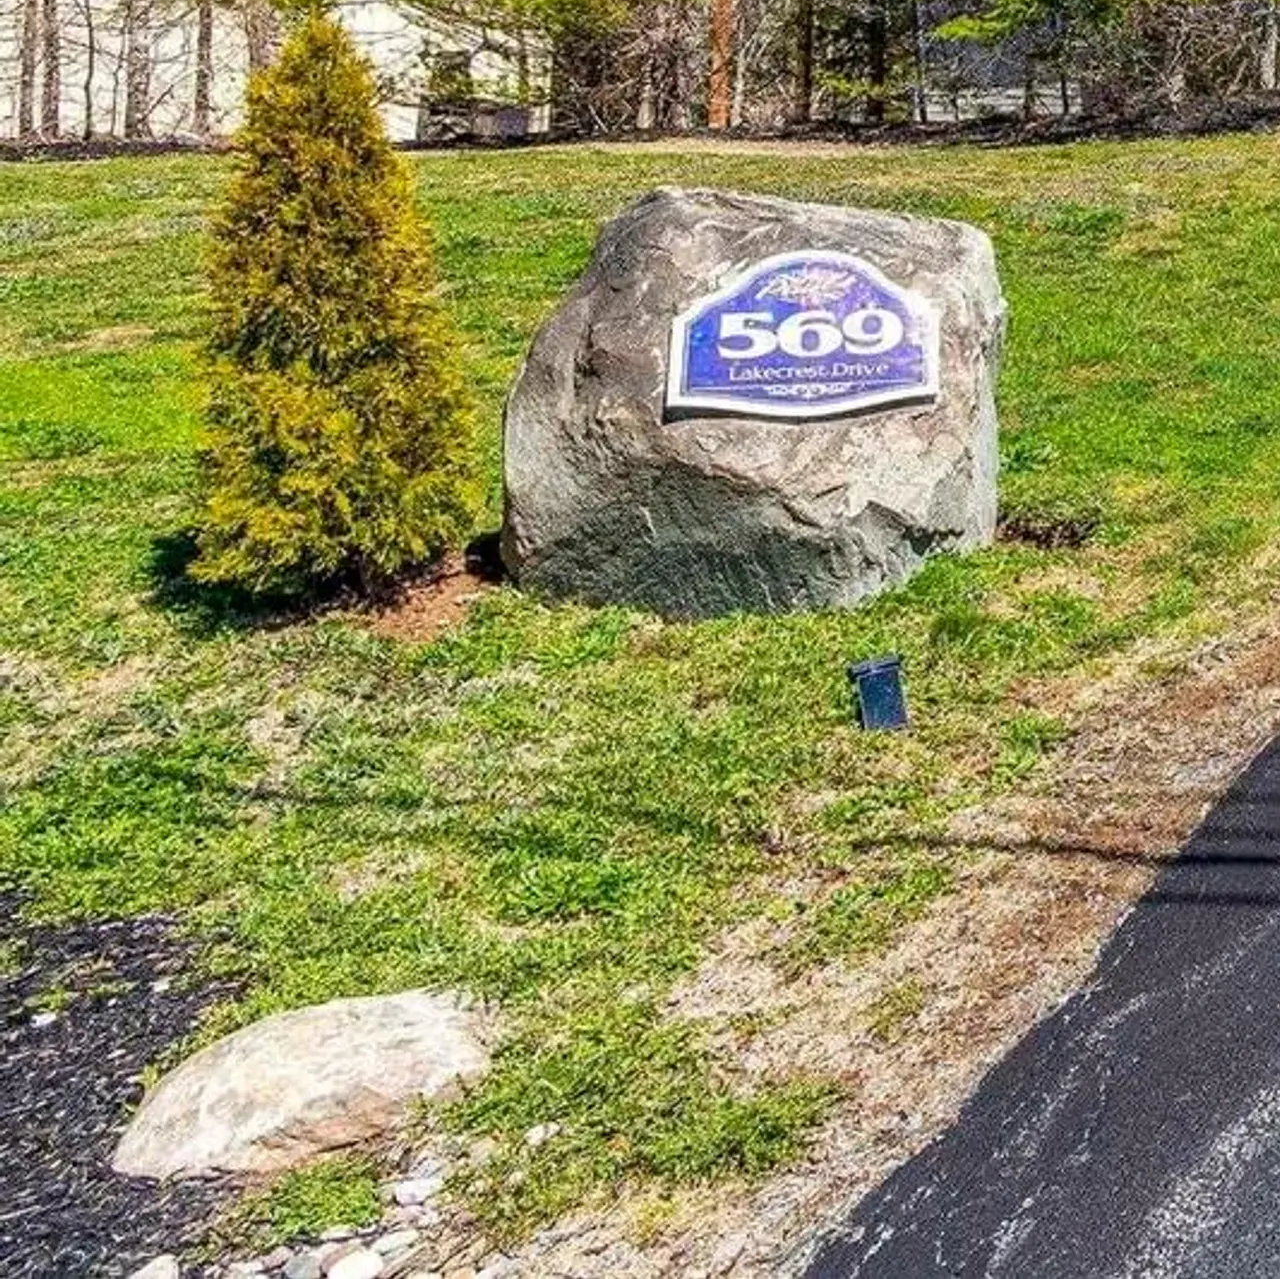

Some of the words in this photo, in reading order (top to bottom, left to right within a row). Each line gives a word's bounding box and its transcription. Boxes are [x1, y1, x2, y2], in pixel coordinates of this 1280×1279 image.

[716, 308, 904, 360] 569
[729, 365, 827, 381] Lakecrest
[831, 361, 889, 377] Drive
